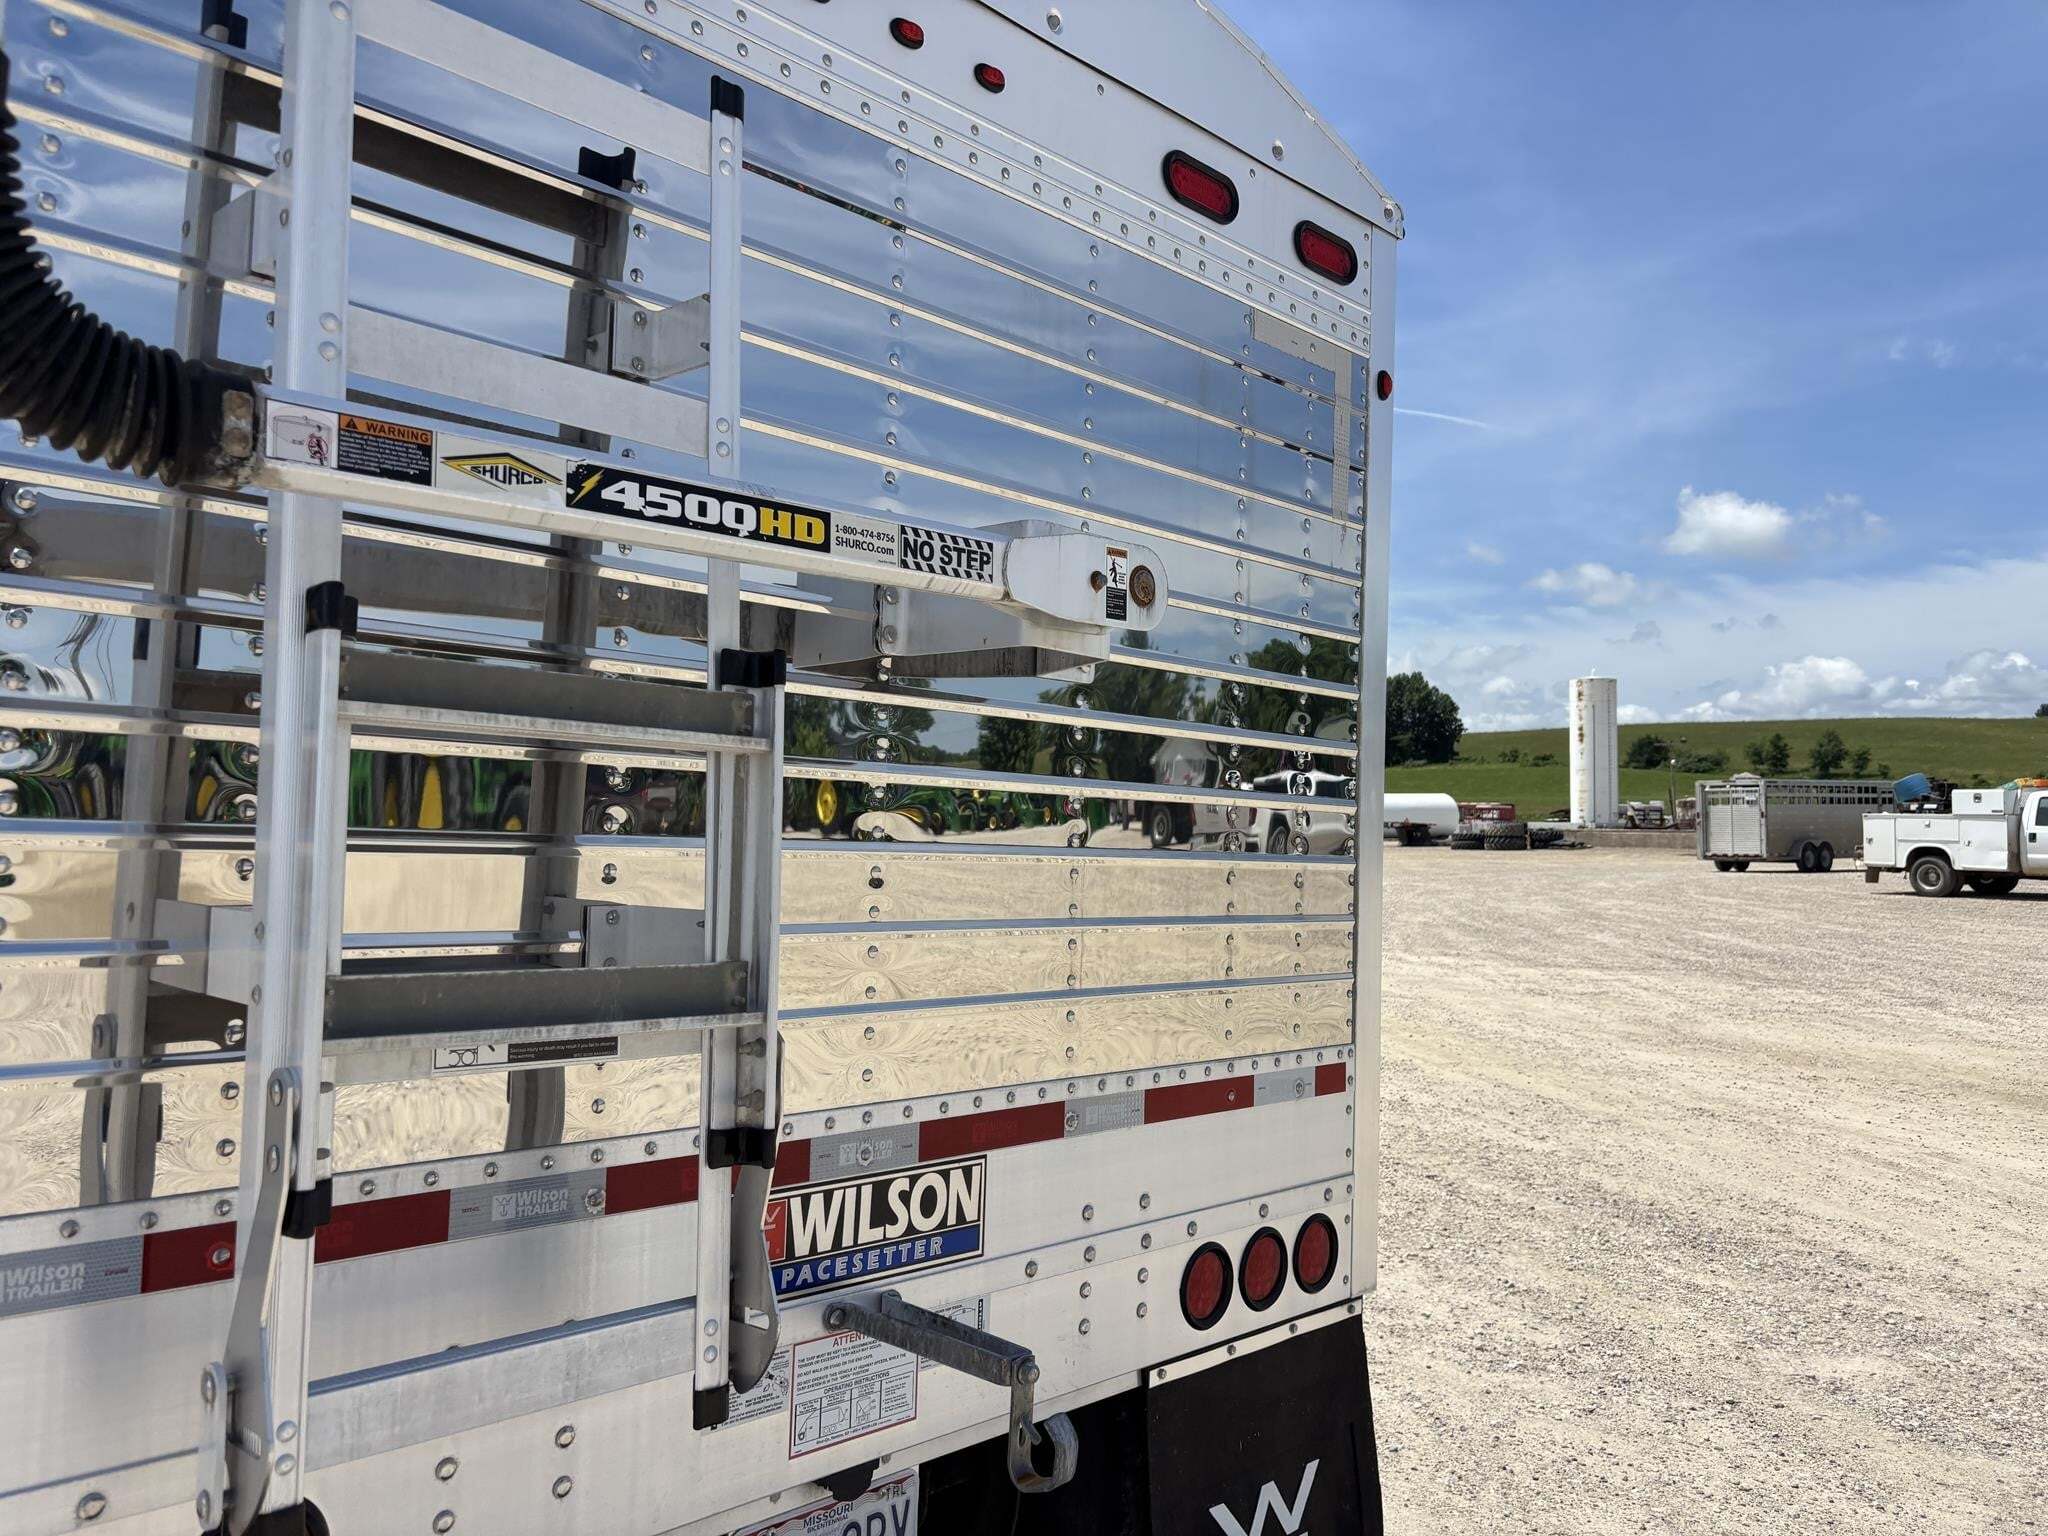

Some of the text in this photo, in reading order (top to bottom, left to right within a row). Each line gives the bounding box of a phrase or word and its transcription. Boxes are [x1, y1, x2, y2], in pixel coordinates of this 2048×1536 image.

[366, 421, 429, 442] WARNING
[835, 524, 895, 543] 1-800-474-8756
[835, 536, 895, 556] SHURCO.com
[903, 536, 991, 571] NO STEP
[517, 1188, 569, 1205] Wilson
[516, 1200, 568, 1217] TRAILER
[790, 1165, 981, 1257] WILSON
[781, 1236, 942, 1289] PACESETTER
[7, 1262, 86, 1287] Wilson
[6, 1277, 84, 1301] TRAILER
[832, 1333, 865, 1348] ATTENT
[824, 1380, 853, 1395] OPERATING
[854, 1371, 890, 1387] INSTRUCTIONS
[803, 1502, 854, 1529] MISSOURI
[807, 1513, 849, 1534] BICENTENNIAL
